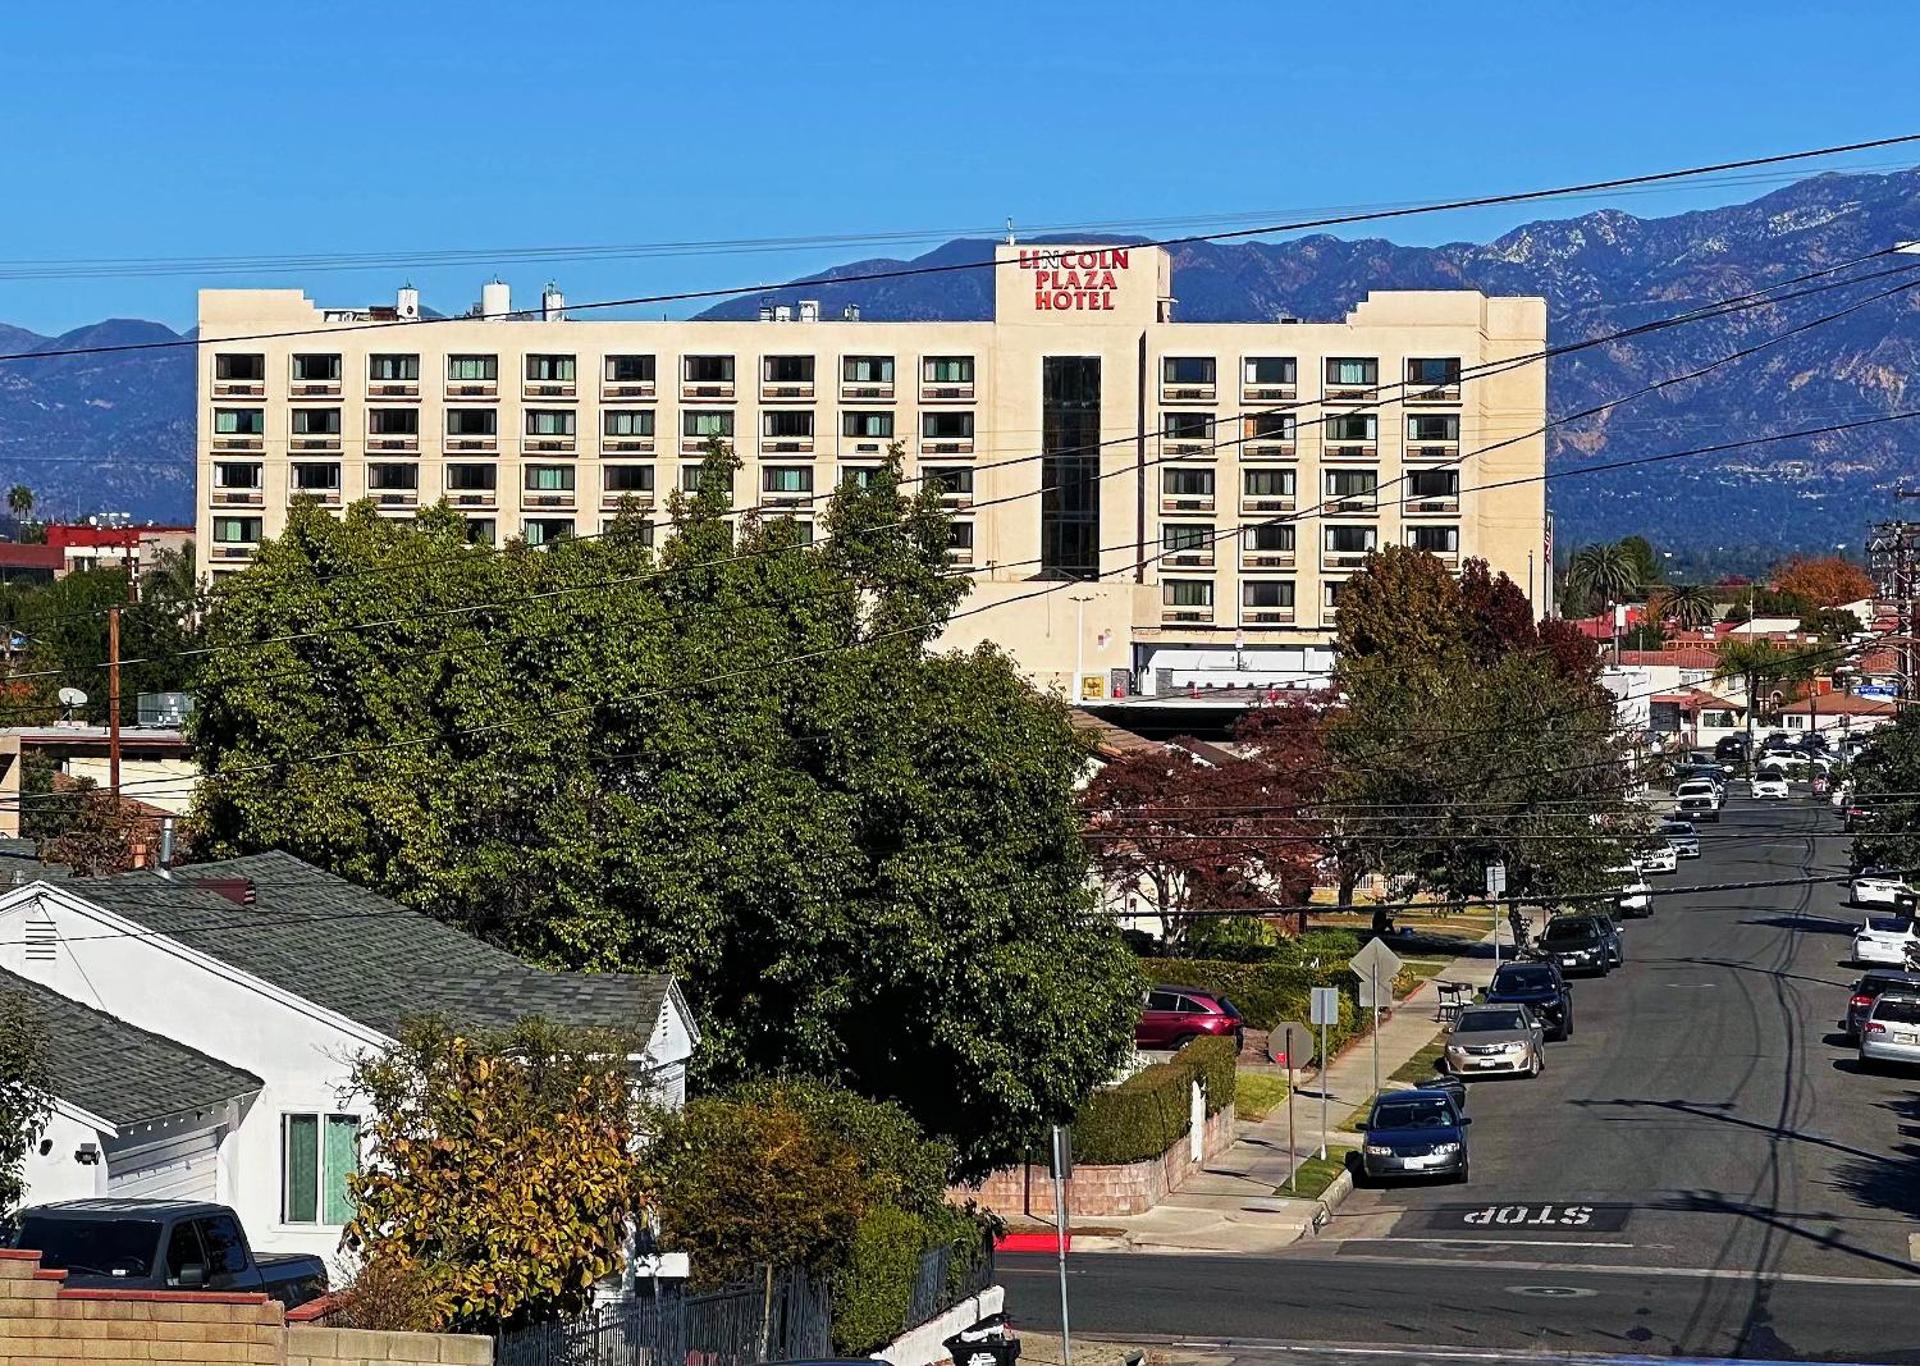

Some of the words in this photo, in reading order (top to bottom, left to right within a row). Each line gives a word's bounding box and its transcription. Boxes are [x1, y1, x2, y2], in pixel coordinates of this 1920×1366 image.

[1019, 250, 1129, 269] LINCOLN
[1035, 270, 1118, 290] PLAZA
[1035, 291, 1115, 310] HOTEL
[1463, 1205, 1593, 1225] STOP
